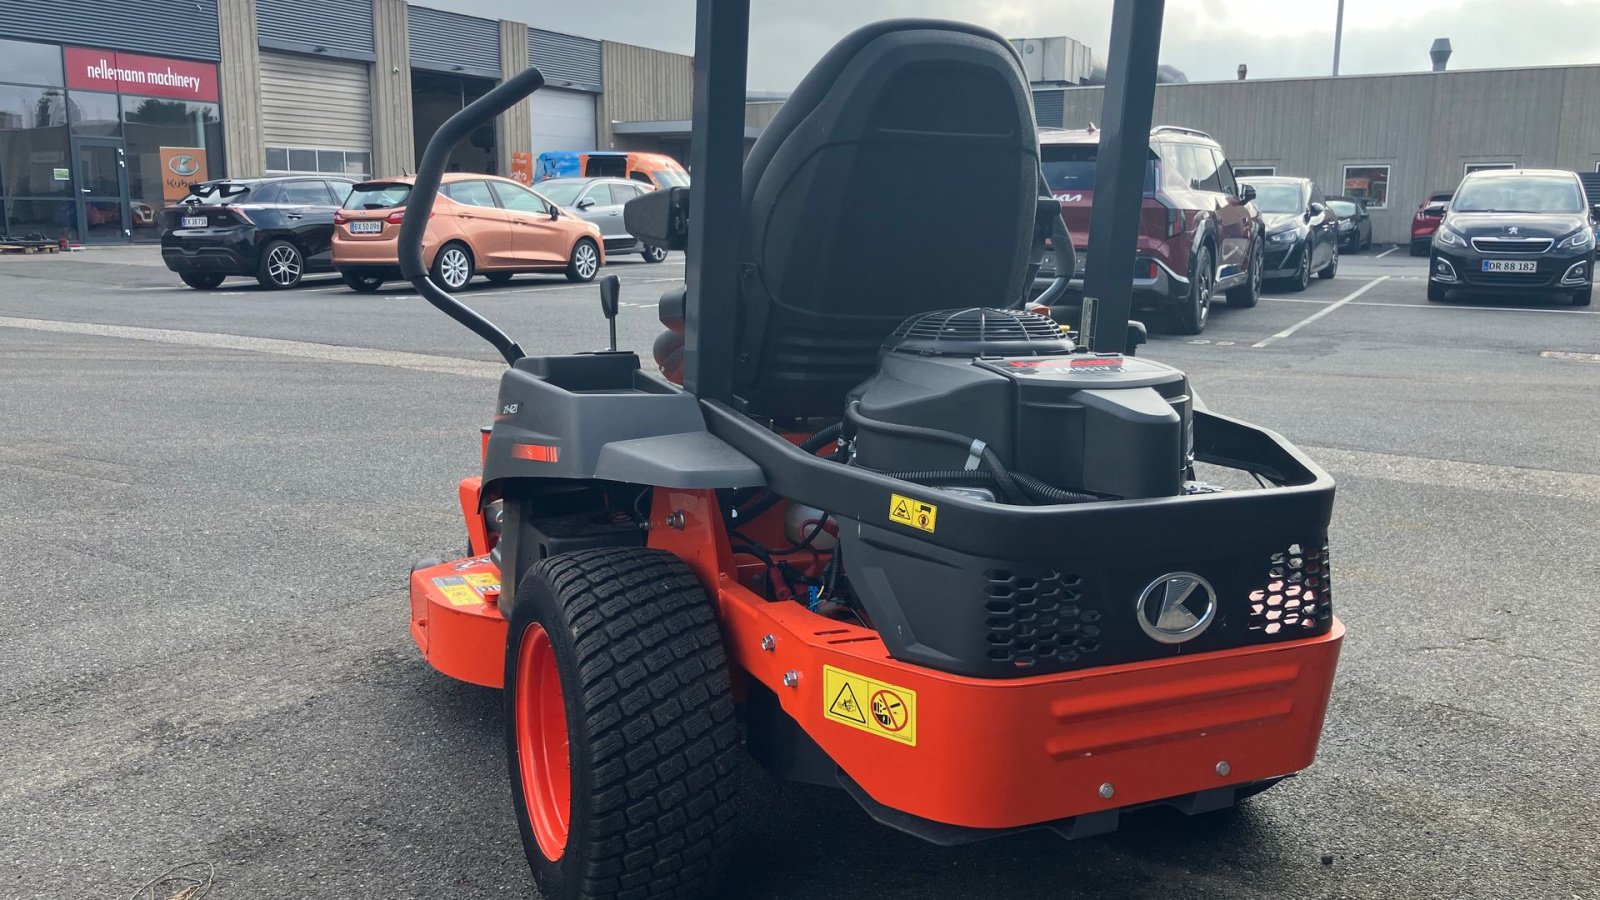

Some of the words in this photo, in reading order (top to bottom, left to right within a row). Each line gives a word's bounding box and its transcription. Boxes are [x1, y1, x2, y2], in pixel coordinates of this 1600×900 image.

[87, 59, 145, 83] nellemann
[147, 67, 200, 92] machinery
[1489, 262, 1501, 271] DR
[1503, 262, 1515, 271] 88
[1518, 262, 1535, 271] 182
